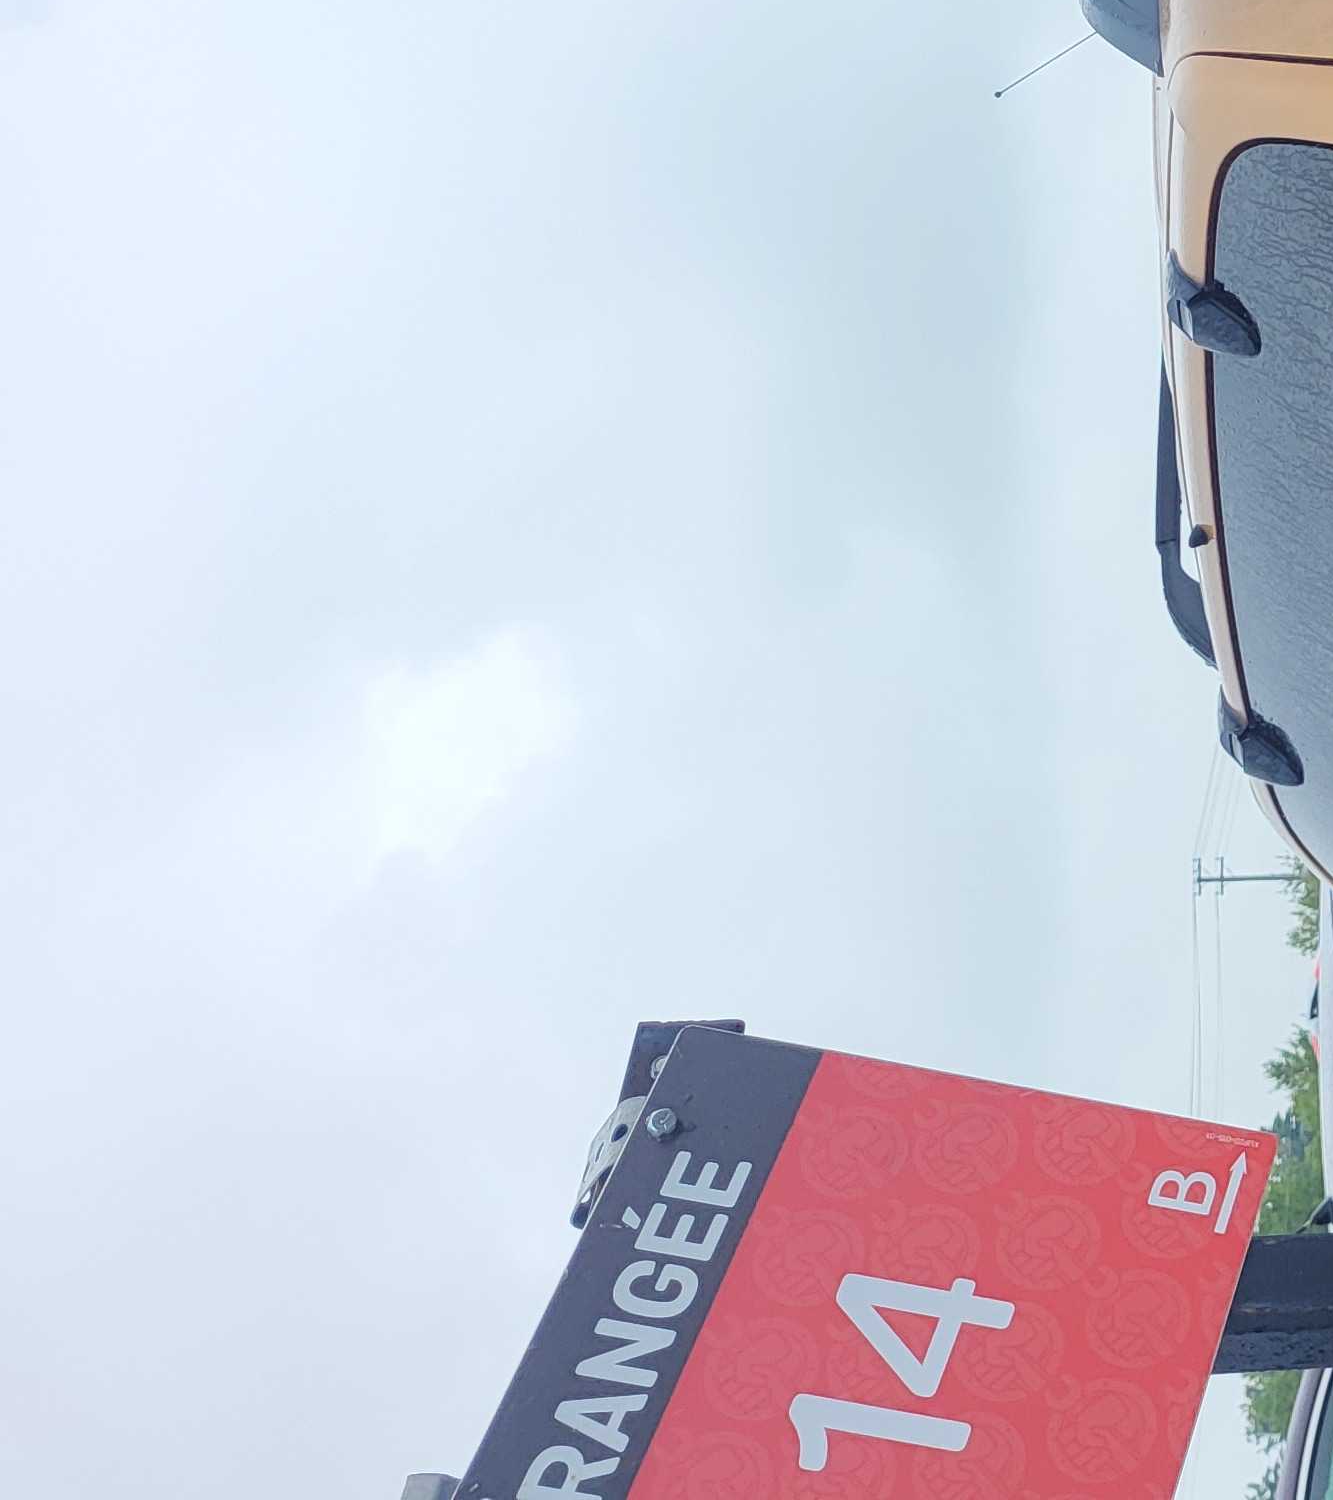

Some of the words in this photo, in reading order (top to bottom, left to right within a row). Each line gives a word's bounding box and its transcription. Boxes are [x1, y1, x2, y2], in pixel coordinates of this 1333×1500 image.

[1147, 1168, 1216, 1216] B
[516, 1150, 753, 1500] RANGÉE
[789, 1273, 1015, 1472] 14
